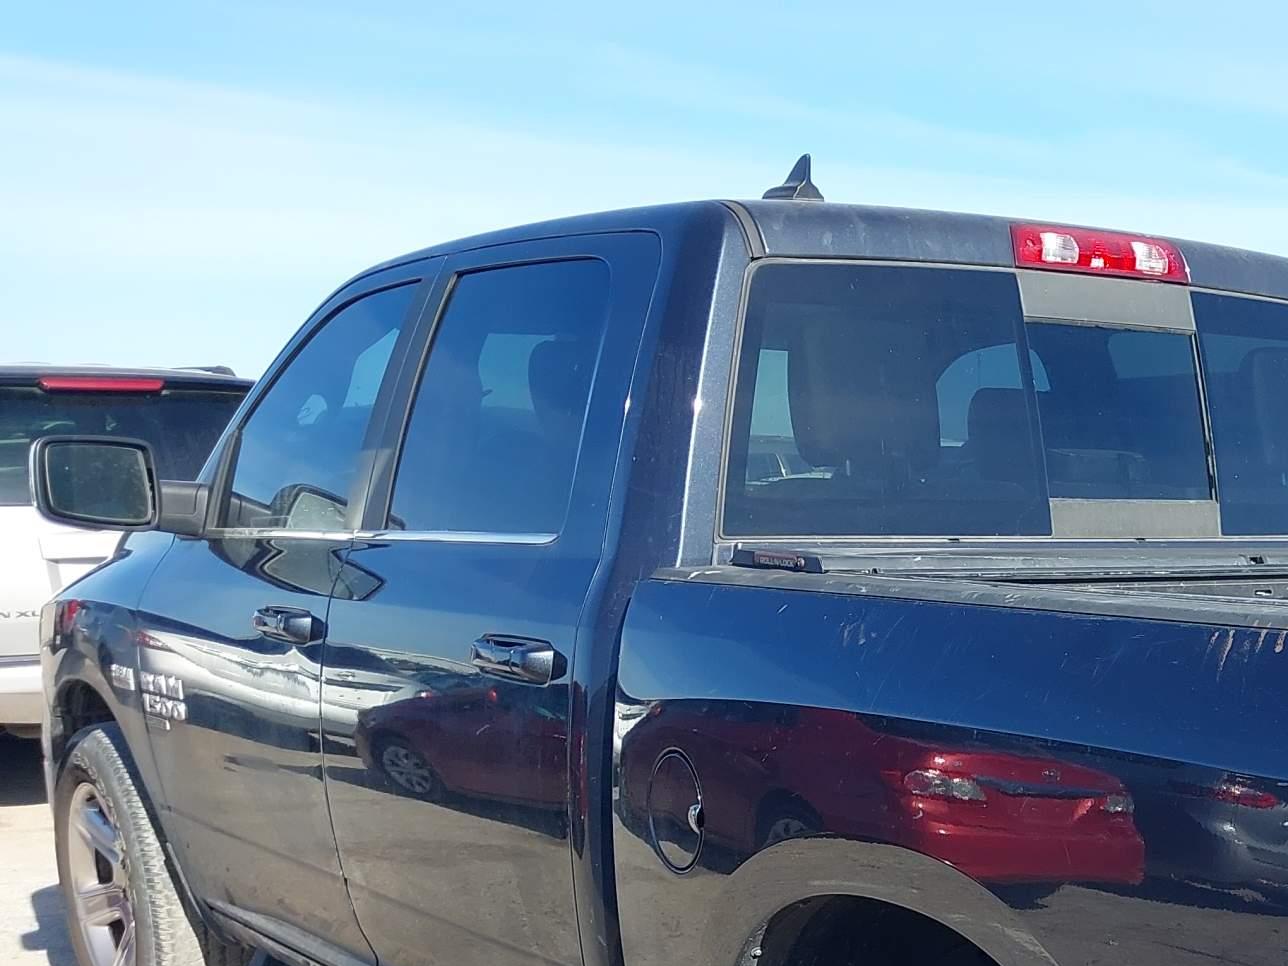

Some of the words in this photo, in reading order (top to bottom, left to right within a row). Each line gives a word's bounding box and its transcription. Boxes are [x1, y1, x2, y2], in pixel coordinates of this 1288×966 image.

[15, 610, 40, 618] XL
[140, 671, 184, 700] RAM
[142, 693, 188, 721] 1500
